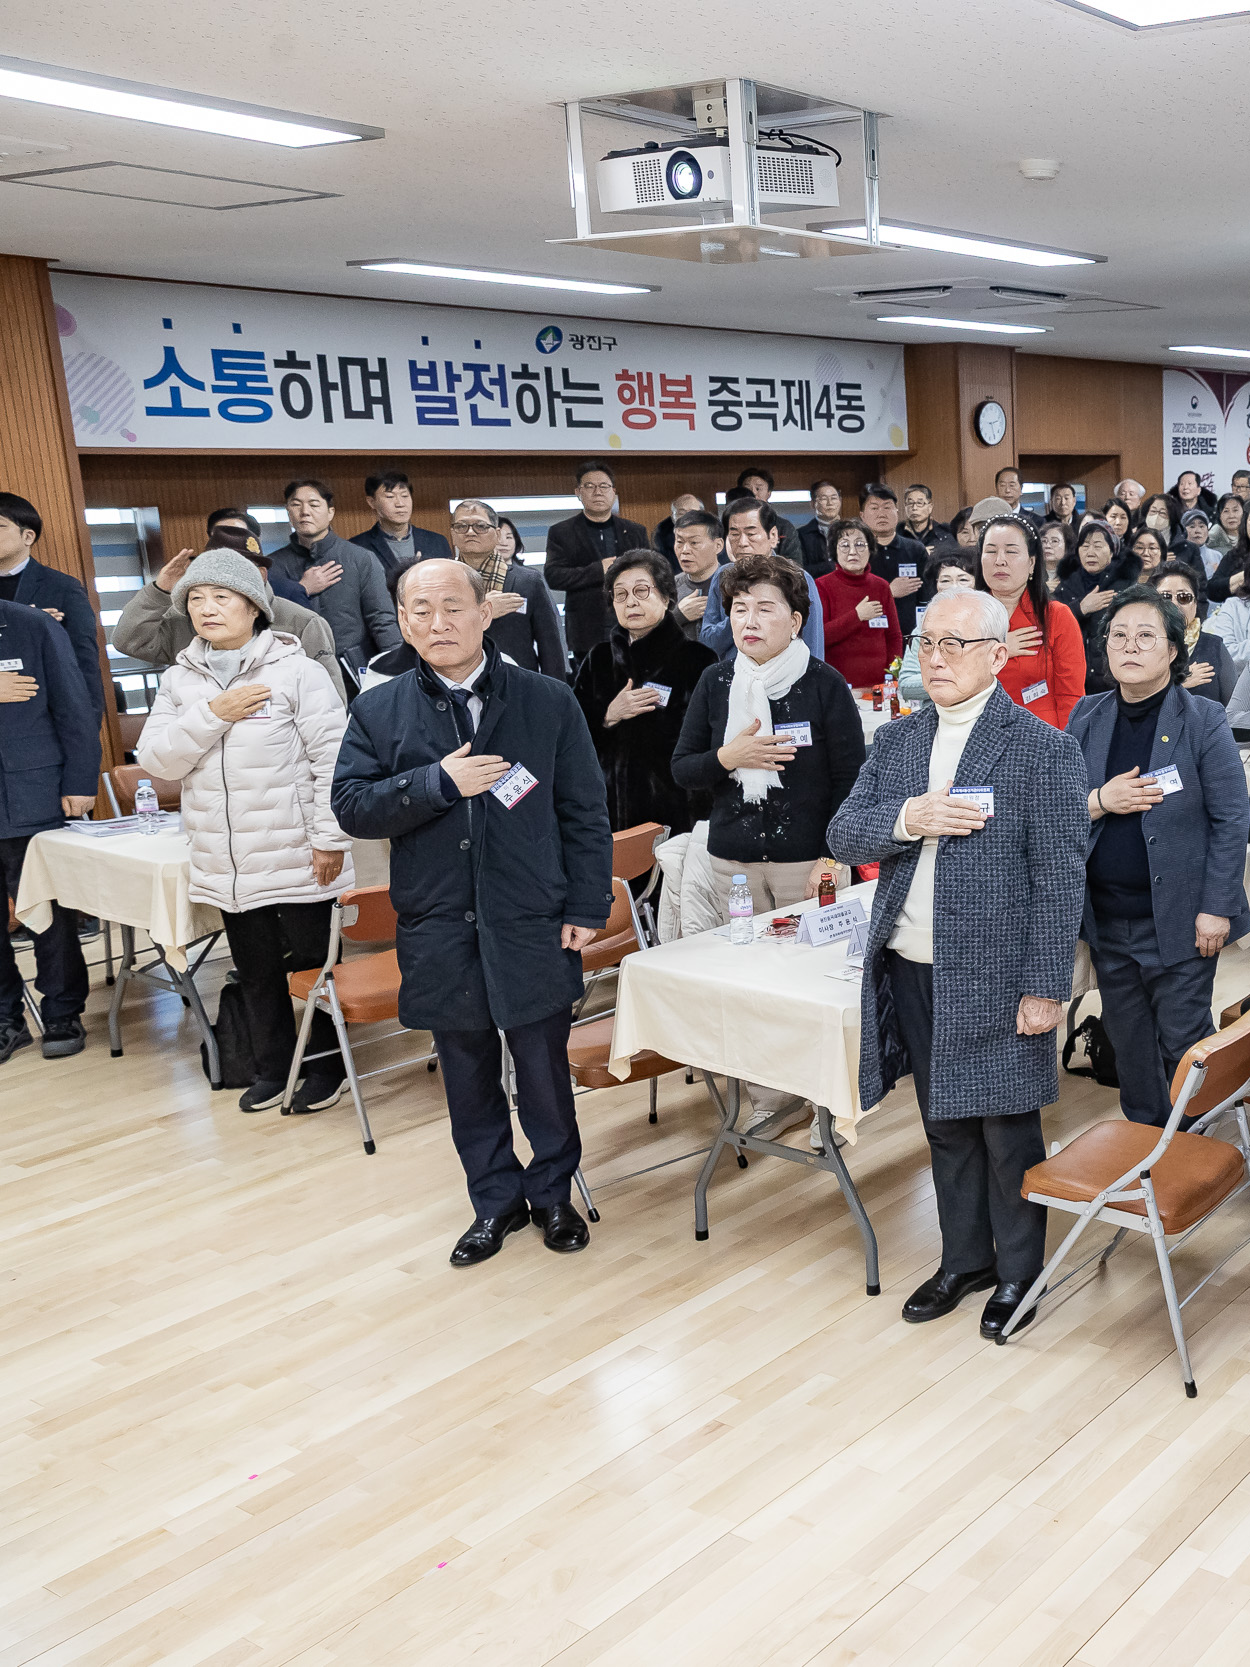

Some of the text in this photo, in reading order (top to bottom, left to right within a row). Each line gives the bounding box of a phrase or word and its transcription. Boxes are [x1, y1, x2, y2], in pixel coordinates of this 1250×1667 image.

[568, 333, 618, 353] 광진구
[142, 343, 867, 433] 소통하며 발전하는 행복 중곡제4동
[1171, 436, 1218, 455] 종합청렴도
